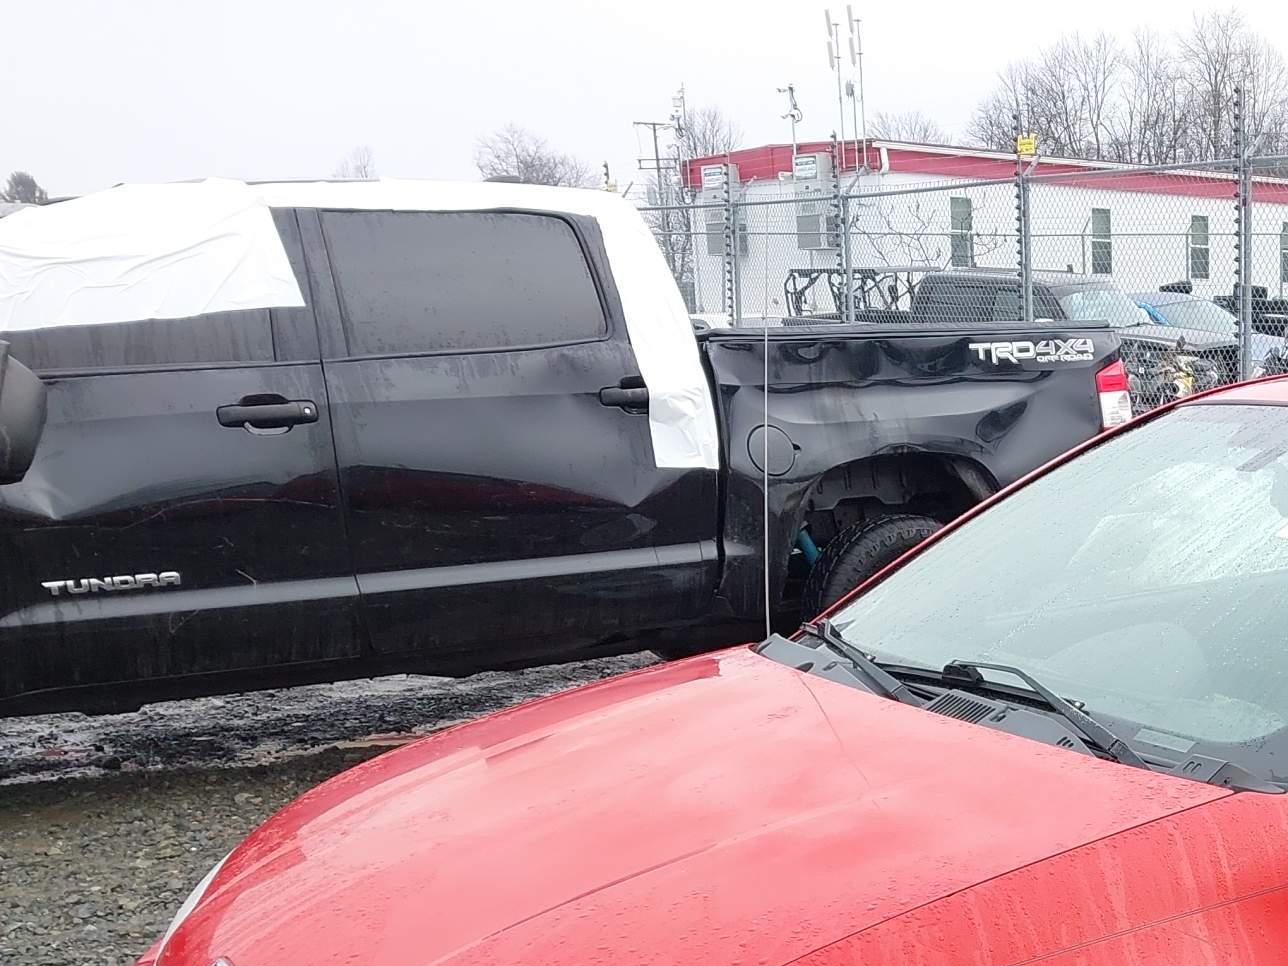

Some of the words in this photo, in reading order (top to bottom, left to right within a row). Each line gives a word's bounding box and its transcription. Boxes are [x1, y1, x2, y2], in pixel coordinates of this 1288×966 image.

[969, 341, 1037, 365] TRD
[1036, 338, 1095, 356] 4X4
[41, 571, 182, 596] TUNDRA
